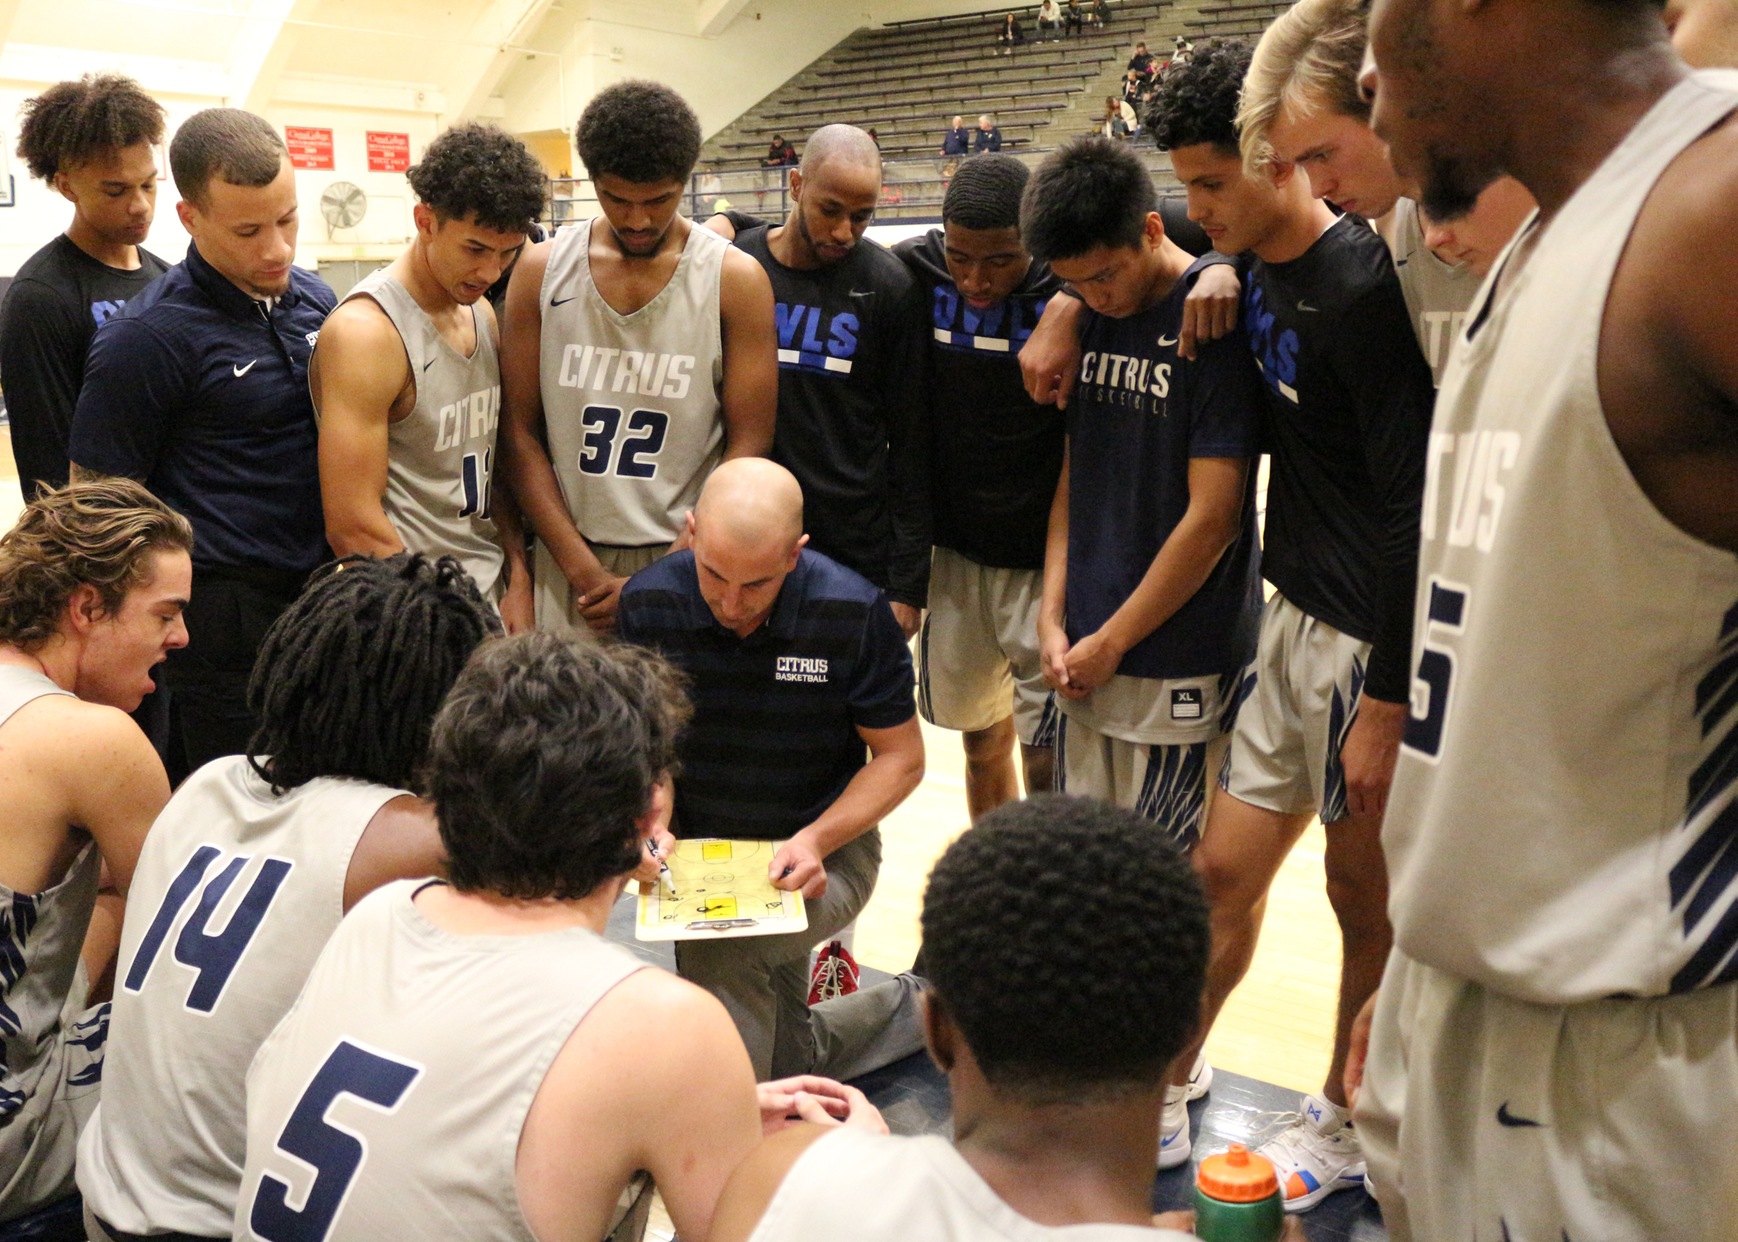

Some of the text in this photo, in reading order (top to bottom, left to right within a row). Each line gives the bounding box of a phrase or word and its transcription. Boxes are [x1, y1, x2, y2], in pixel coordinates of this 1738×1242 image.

[558, 344, 696, 399] CITRUS
[1081, 352, 1171, 399] CITRUS
[434, 384, 500, 452] CITR
[577, 403, 671, 481] 32
[457, 444, 492, 521] 1
[775, 672, 829, 683] BASKETBALL
[776, 656, 829, 674] CITRUS
[1178, 692, 1194, 702] XL
[122, 842, 296, 1018] 14
[247, 1034, 426, 1242] 5
